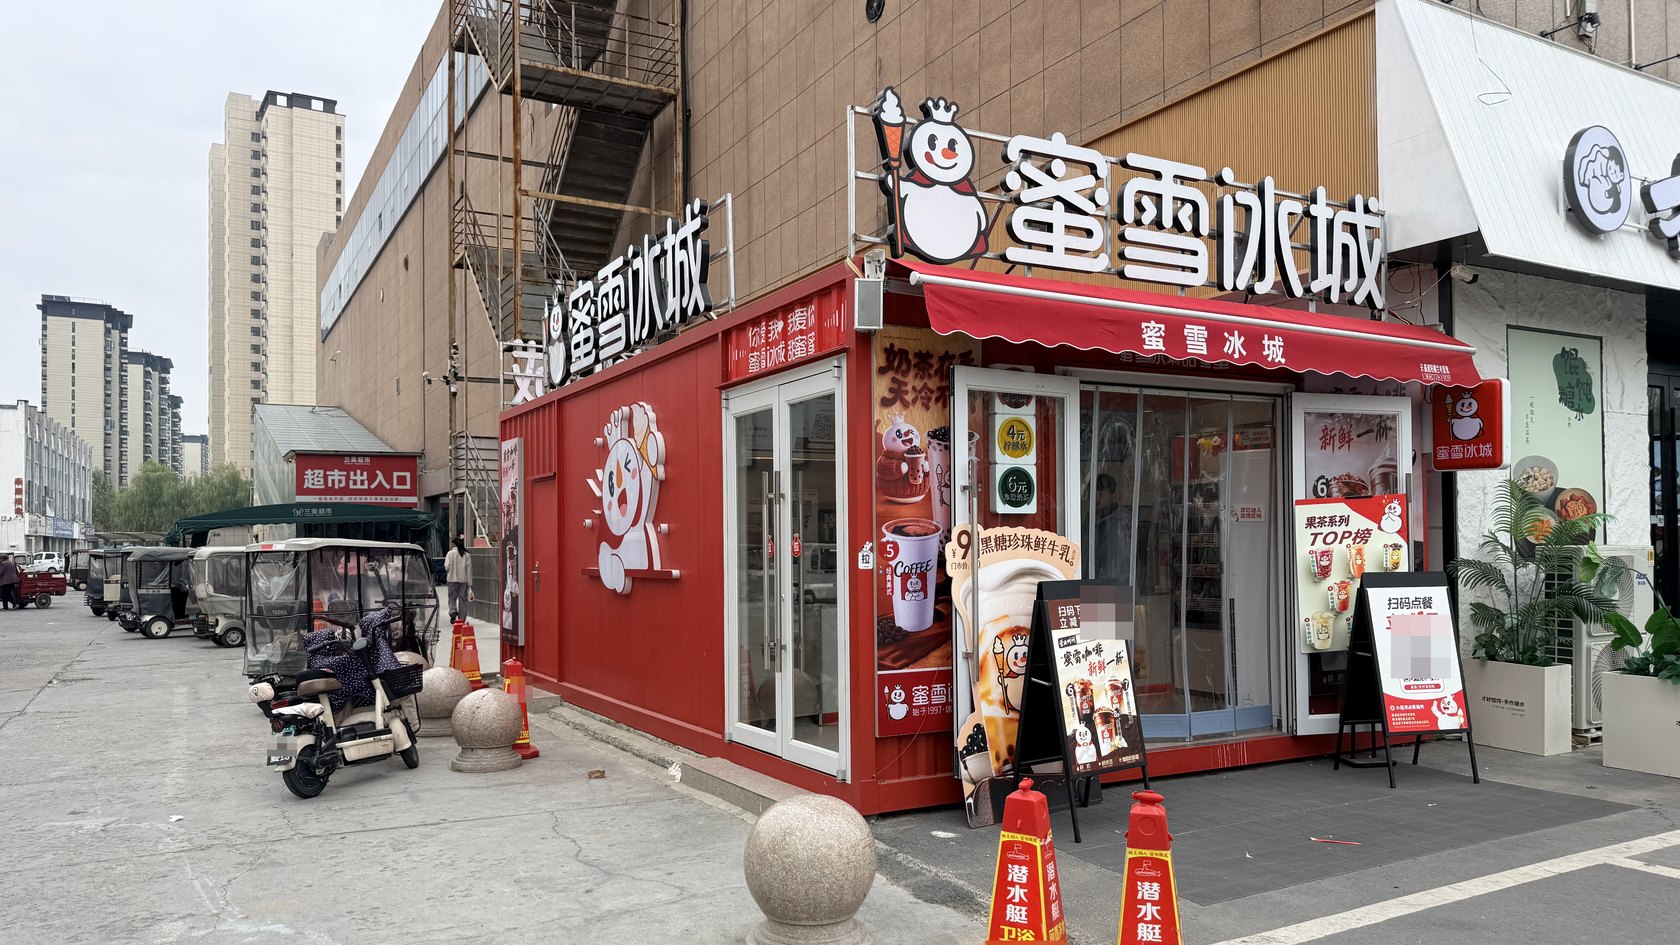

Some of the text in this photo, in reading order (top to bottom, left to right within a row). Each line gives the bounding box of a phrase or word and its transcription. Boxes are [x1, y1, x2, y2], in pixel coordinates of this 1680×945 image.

[1001, 131, 1385, 310] 蜜雪冰城
[568, 197, 712, 374] 蜜雪冰城
[1141, 320, 1286, 365] 蜜雪冰城
[1008, 425, 1027, 441] 4元
[1319, 423, 1393, 455] 新鲜一杯
[1436, 442, 1493, 460] 蜜雪冰城
[303, 468, 412, 490] 超市出入口
[1008, 476, 1028, 493] 6元
[1305, 514, 1350, 529] 果茶系列
[1310, 527, 1373, 547] TOP榜
[861, 553, 870, 565] 拉
[1058, 605, 1080, 617] 扫码下
[1387, 596, 1433, 610] 扫码点餐
[912, 683, 952, 706] 蜜雪
[1005, 863, 1029, 925] 潜水艇
[1045, 861, 1060, 922] 潜水艇
[1136, 881, 1162, 943] 潜水艇
